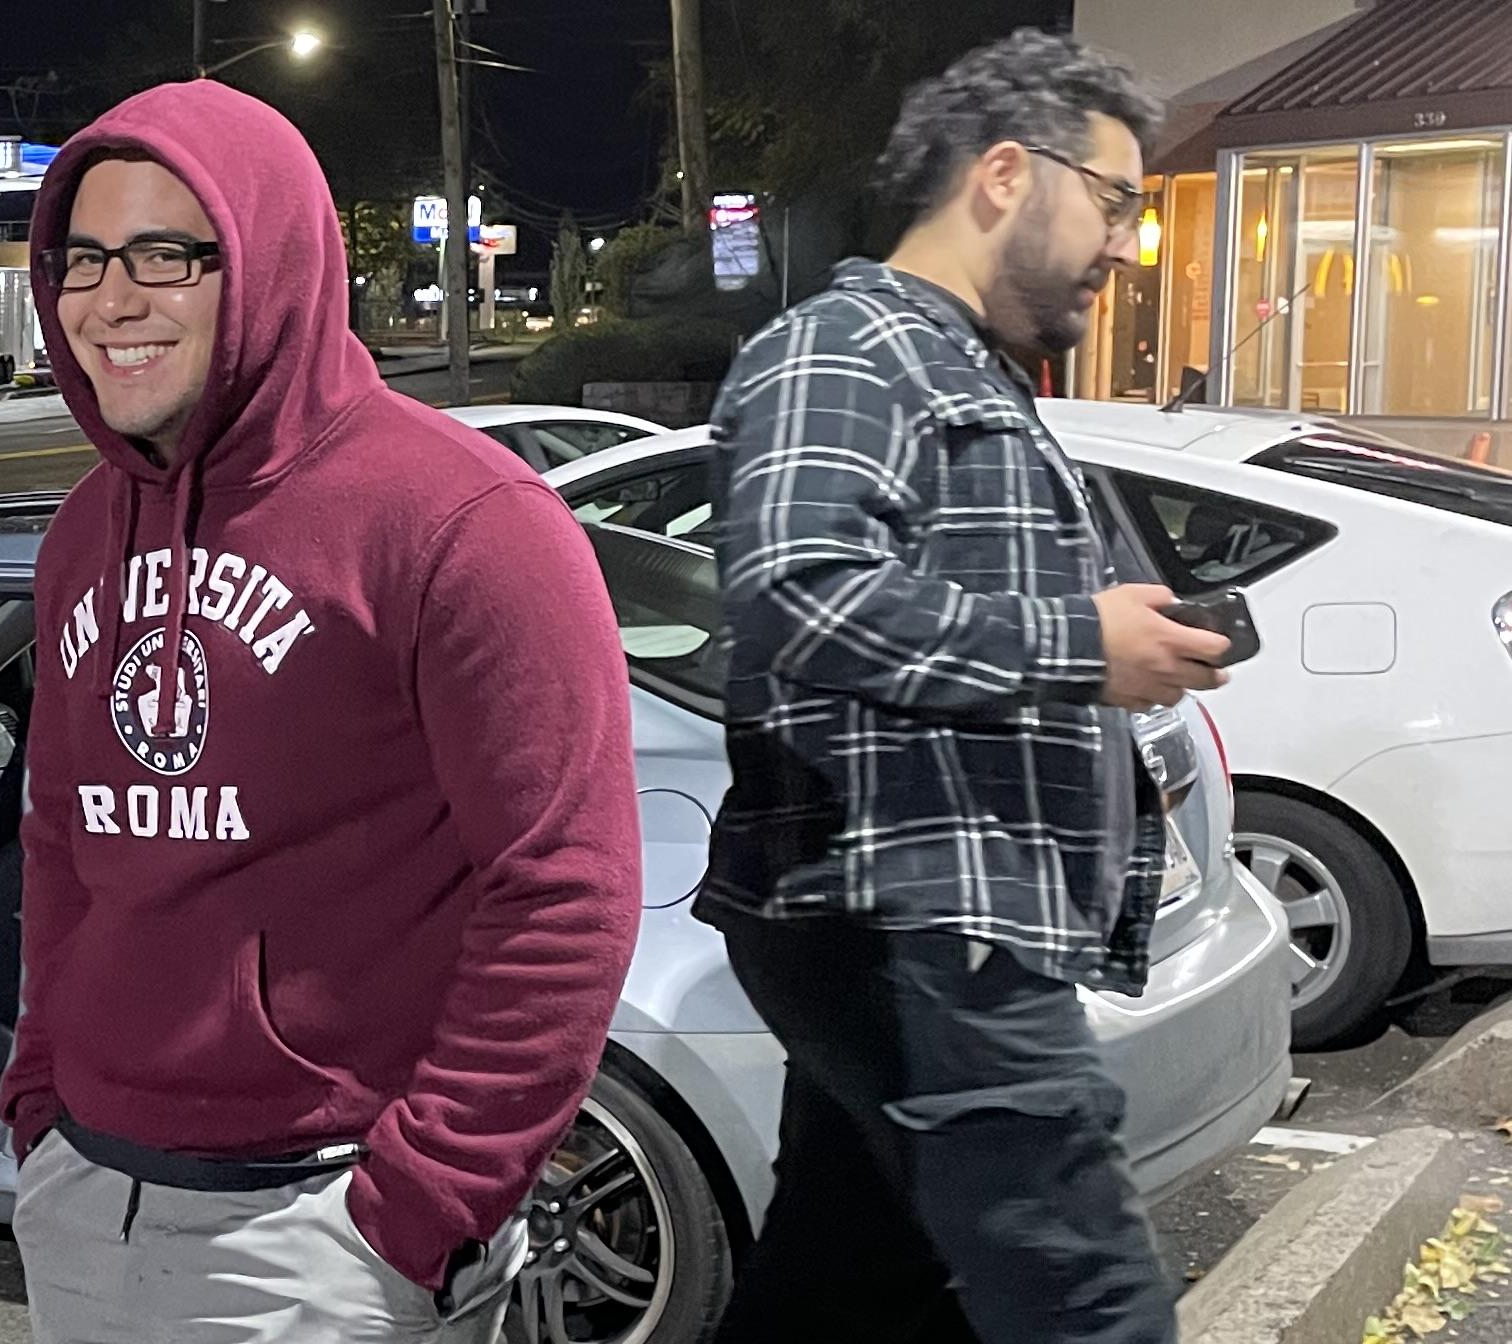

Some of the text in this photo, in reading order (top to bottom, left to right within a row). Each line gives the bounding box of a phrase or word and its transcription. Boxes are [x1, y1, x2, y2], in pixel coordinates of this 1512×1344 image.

[115, 654, 142, 712] STUDI
[137, 741, 199, 769] ROMA
[78, 785, 250, 840] ROMA
